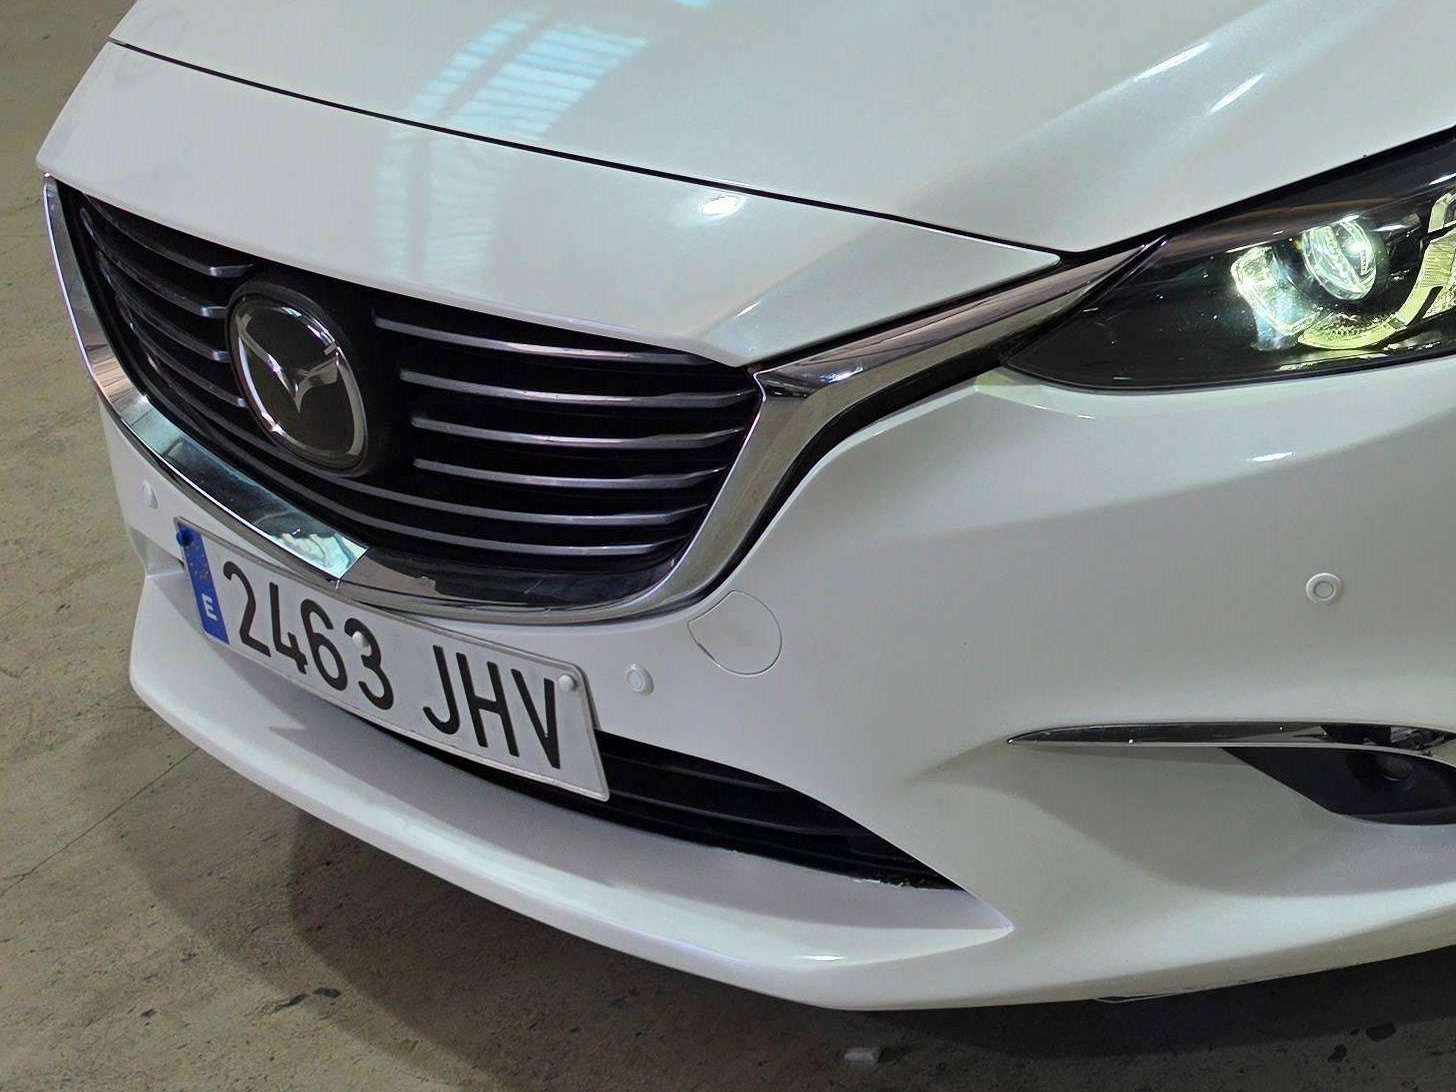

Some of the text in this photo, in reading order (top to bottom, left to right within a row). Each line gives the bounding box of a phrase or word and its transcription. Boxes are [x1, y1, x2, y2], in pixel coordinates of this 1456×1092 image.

[203, 594, 217, 621] E
[223, 561, 561, 769] 2463 JHV
